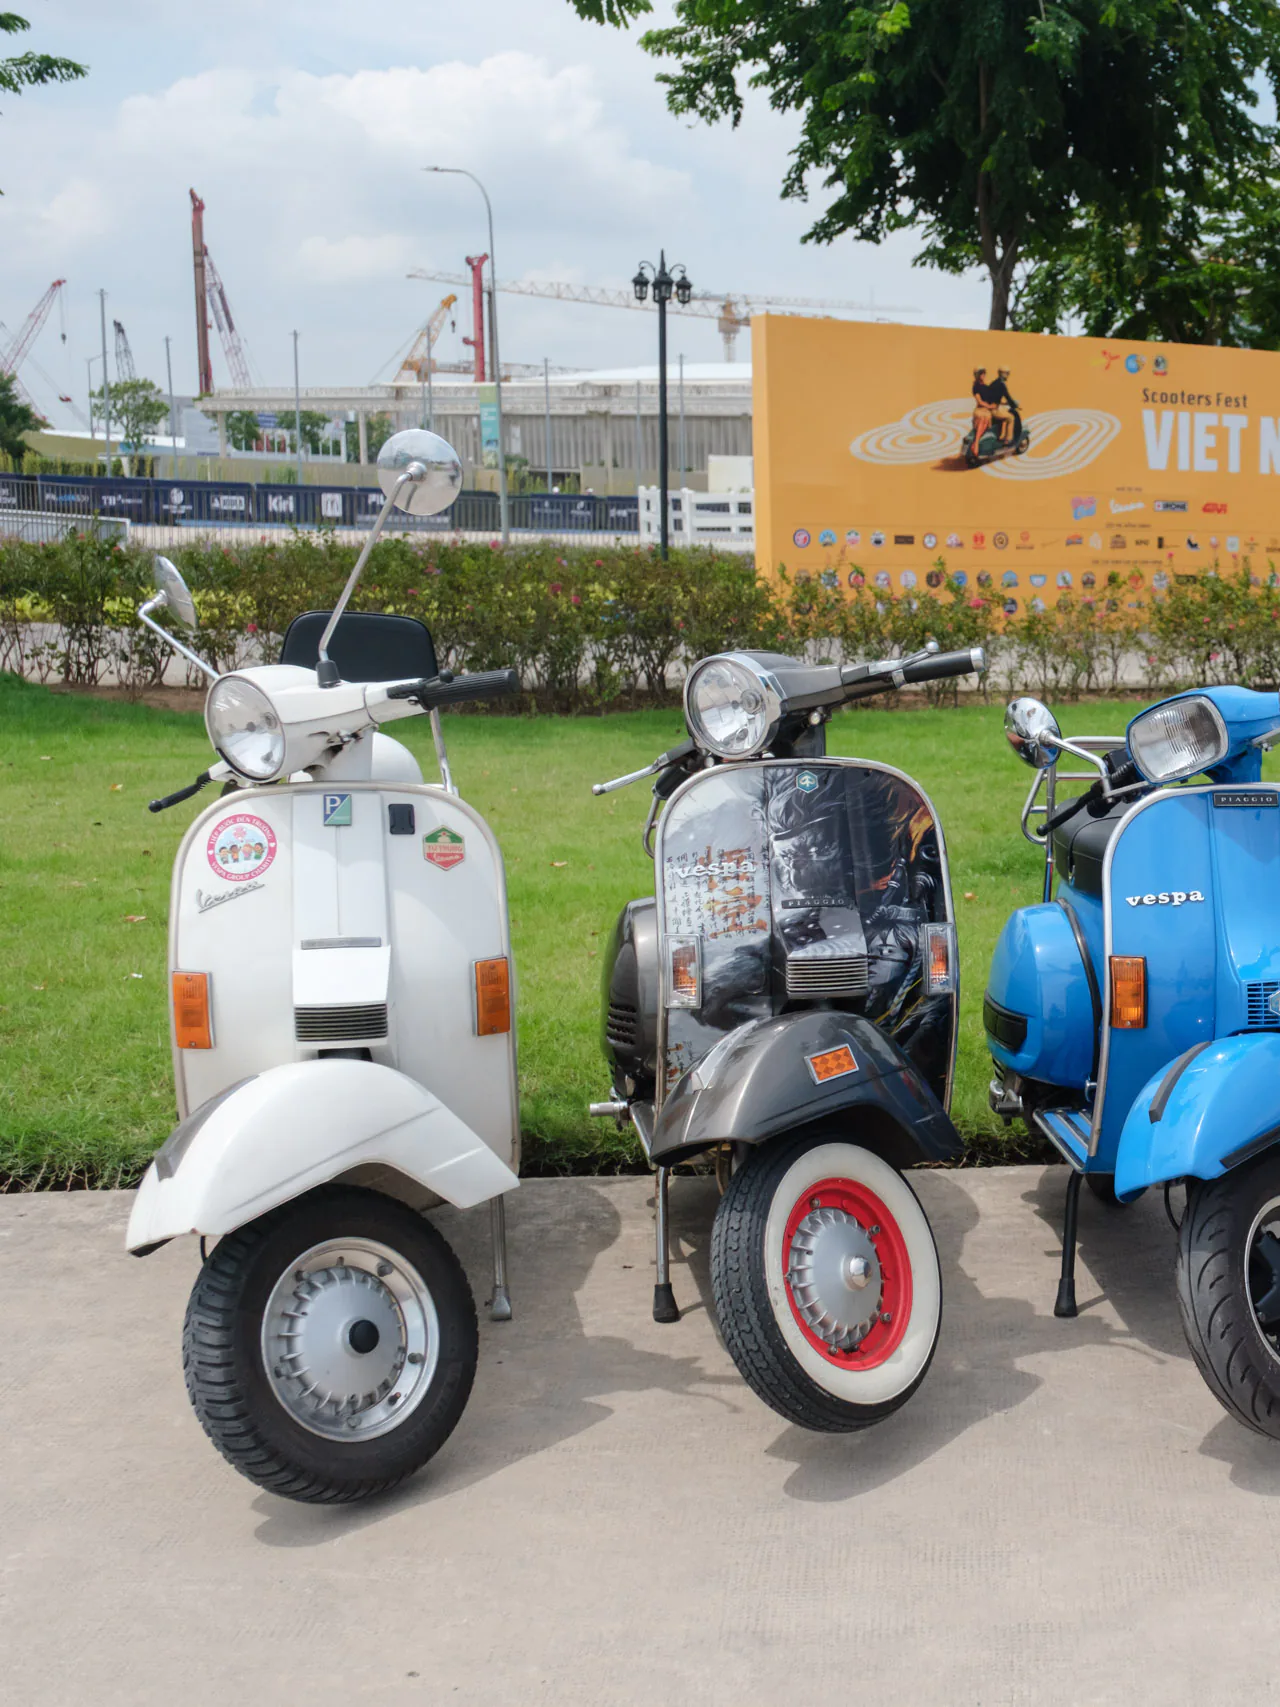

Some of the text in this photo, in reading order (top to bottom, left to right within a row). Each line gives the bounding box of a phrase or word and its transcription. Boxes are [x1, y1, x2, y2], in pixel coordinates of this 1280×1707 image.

[1142, 387, 1248, 408] Scooters Fest
[1142, 409, 1248, 473] VIET
[325, 796, 341, 814] P
[226, 873, 250, 881] GROUP
[251, 855, 273, 877] CHARITY
[675, 861, 757, 879] vespa
[1125, 890, 1205, 907] vespa
